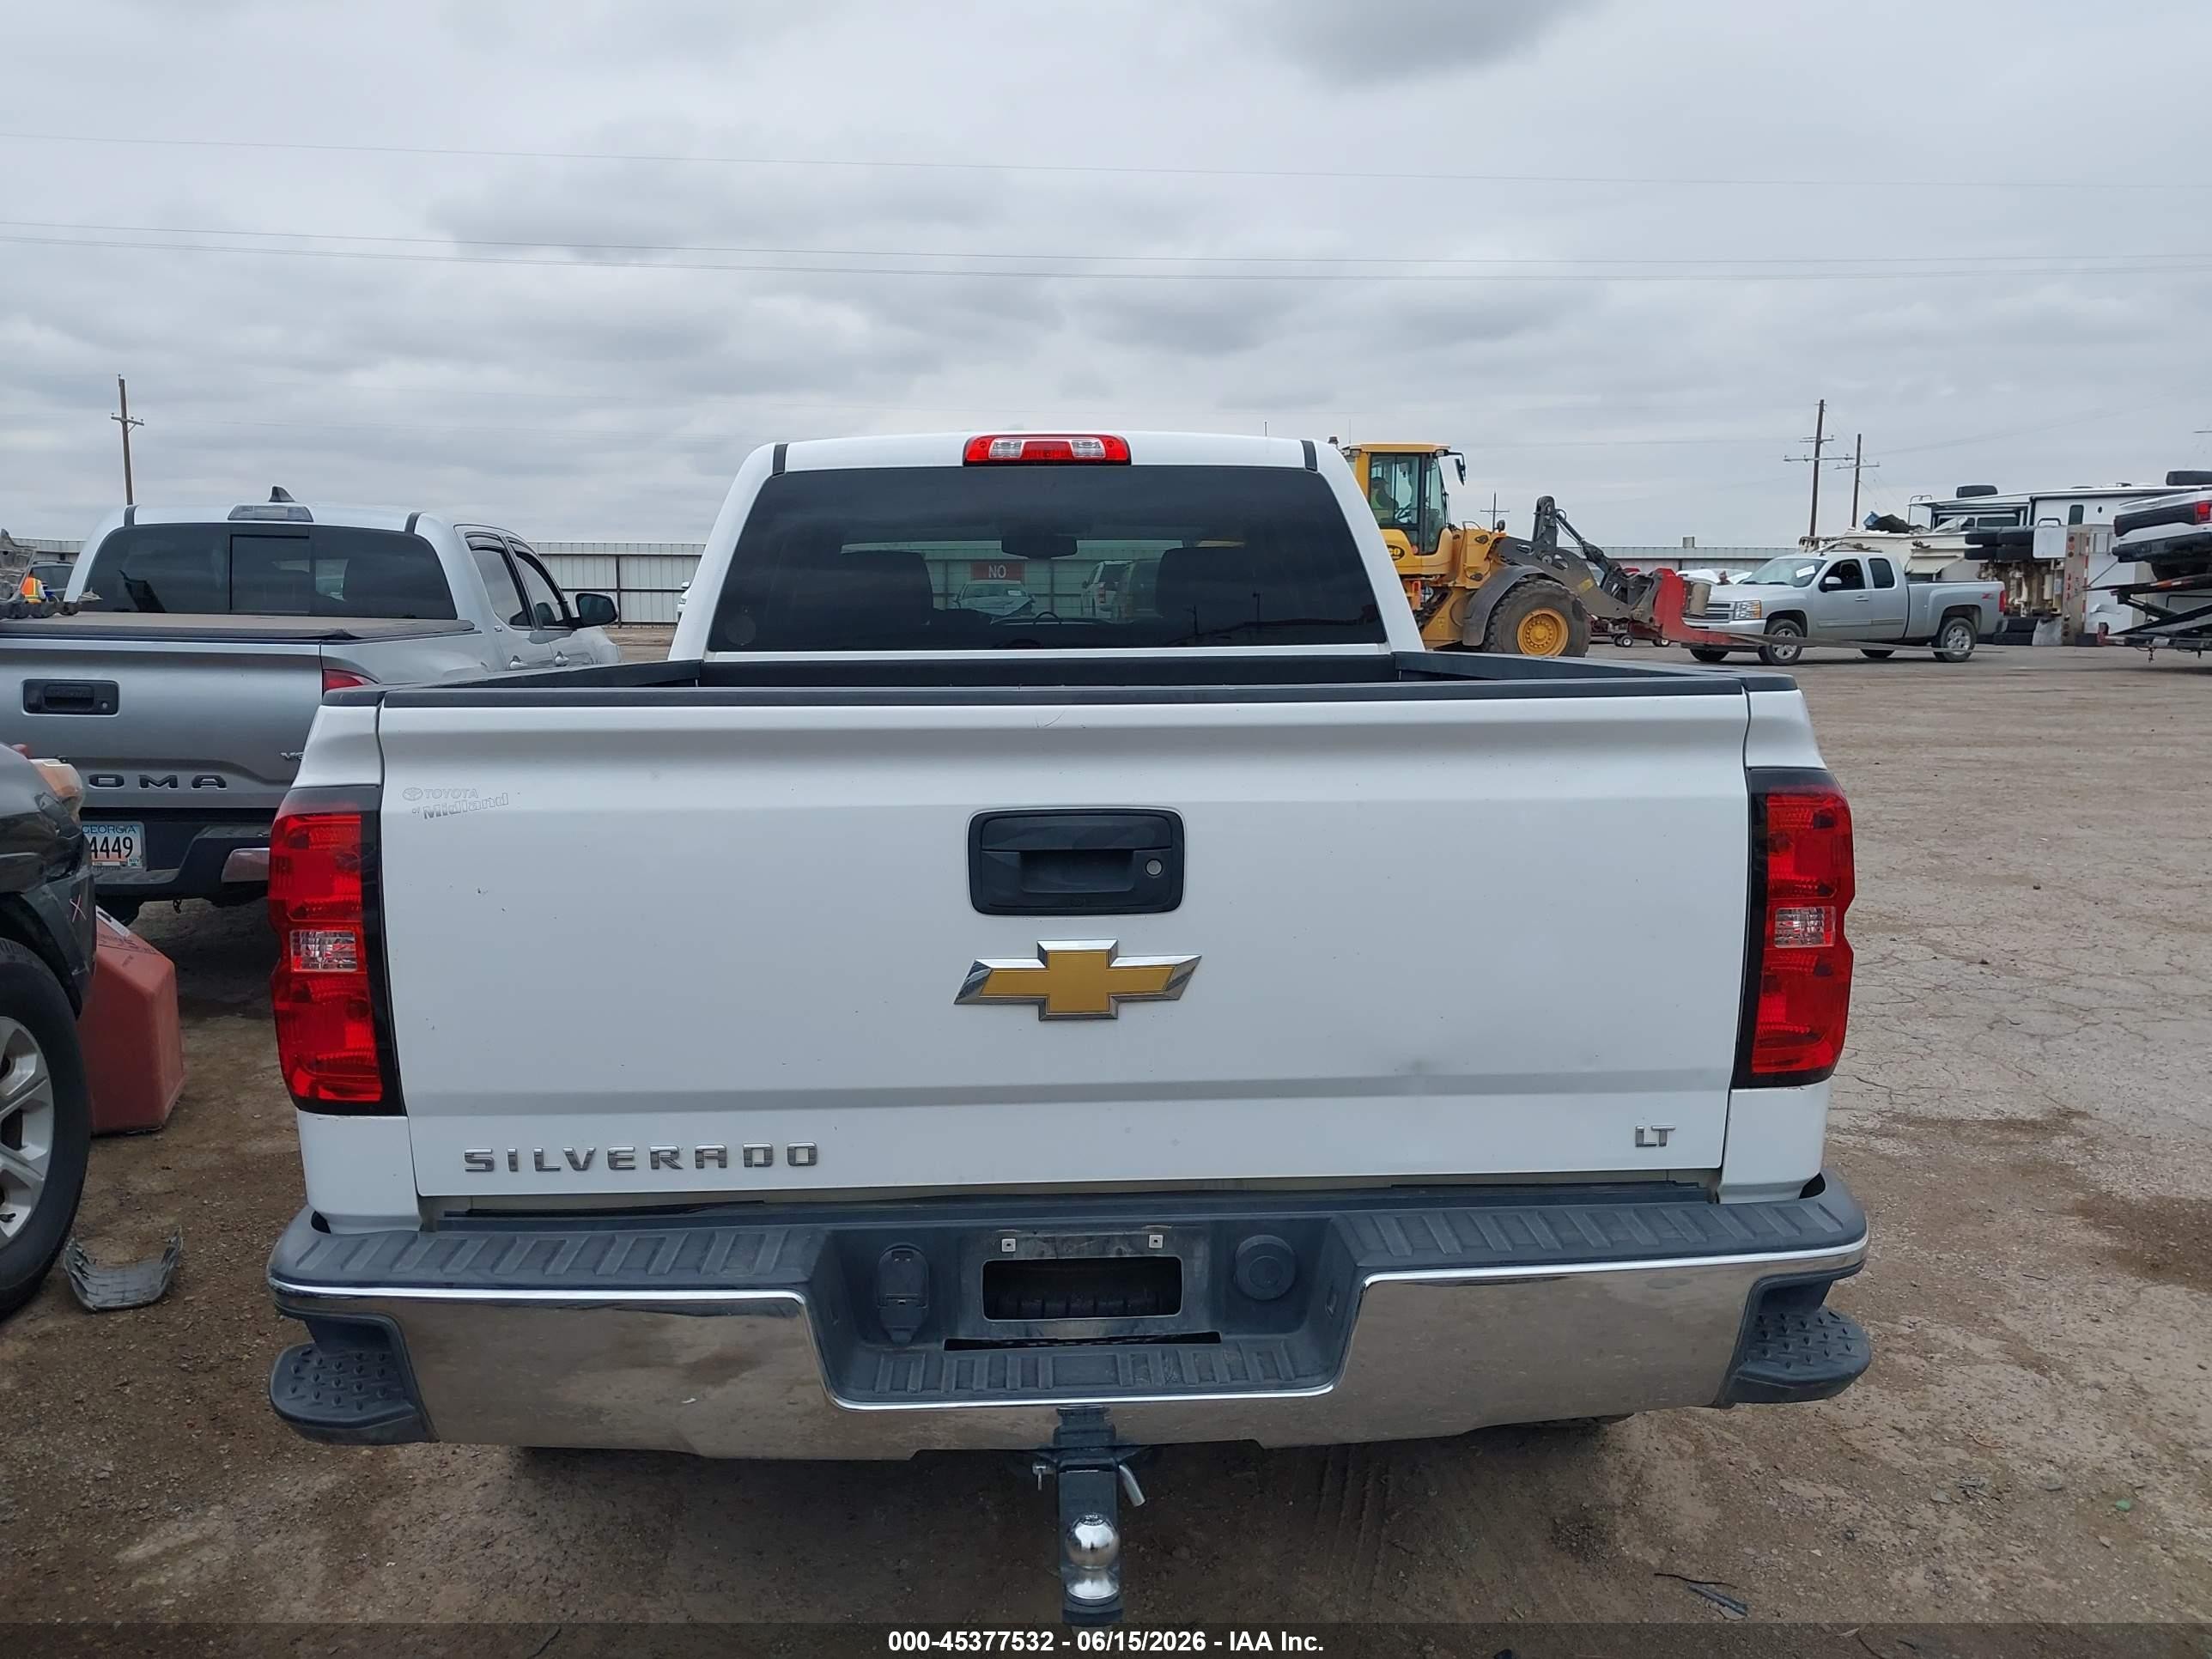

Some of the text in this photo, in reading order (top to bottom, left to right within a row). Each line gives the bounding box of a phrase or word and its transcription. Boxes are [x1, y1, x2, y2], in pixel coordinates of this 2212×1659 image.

[988, 565, 1006, 578] NO
[424, 788, 479, 799] TOYOTA
[423, 793, 508, 819] Midland
[82, 824, 137, 835] GEORGIA
[90, 836, 134, 860] 4449
[1635, 1125, 1676, 1148] LT
[464, 1141, 819, 1173] SILVERADO
